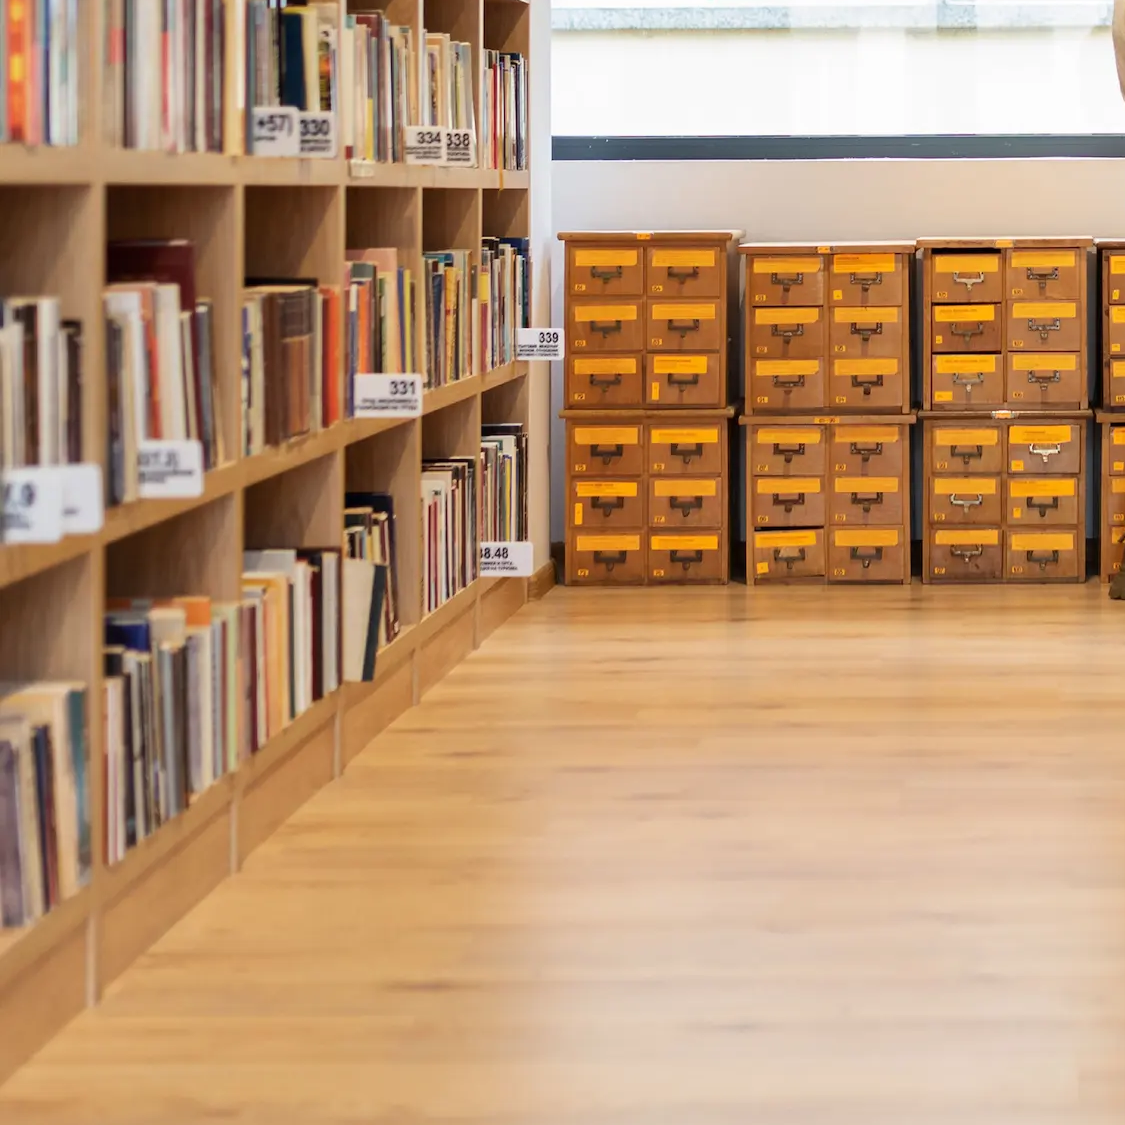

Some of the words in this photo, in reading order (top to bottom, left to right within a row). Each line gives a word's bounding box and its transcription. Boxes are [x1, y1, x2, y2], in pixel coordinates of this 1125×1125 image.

[300, 119, 329, 137] 330
[416, 131, 441, 144] 334
[446, 133, 470, 146] 338
[539, 332, 558, 343] 339
[389, 380, 415, 394] 331
